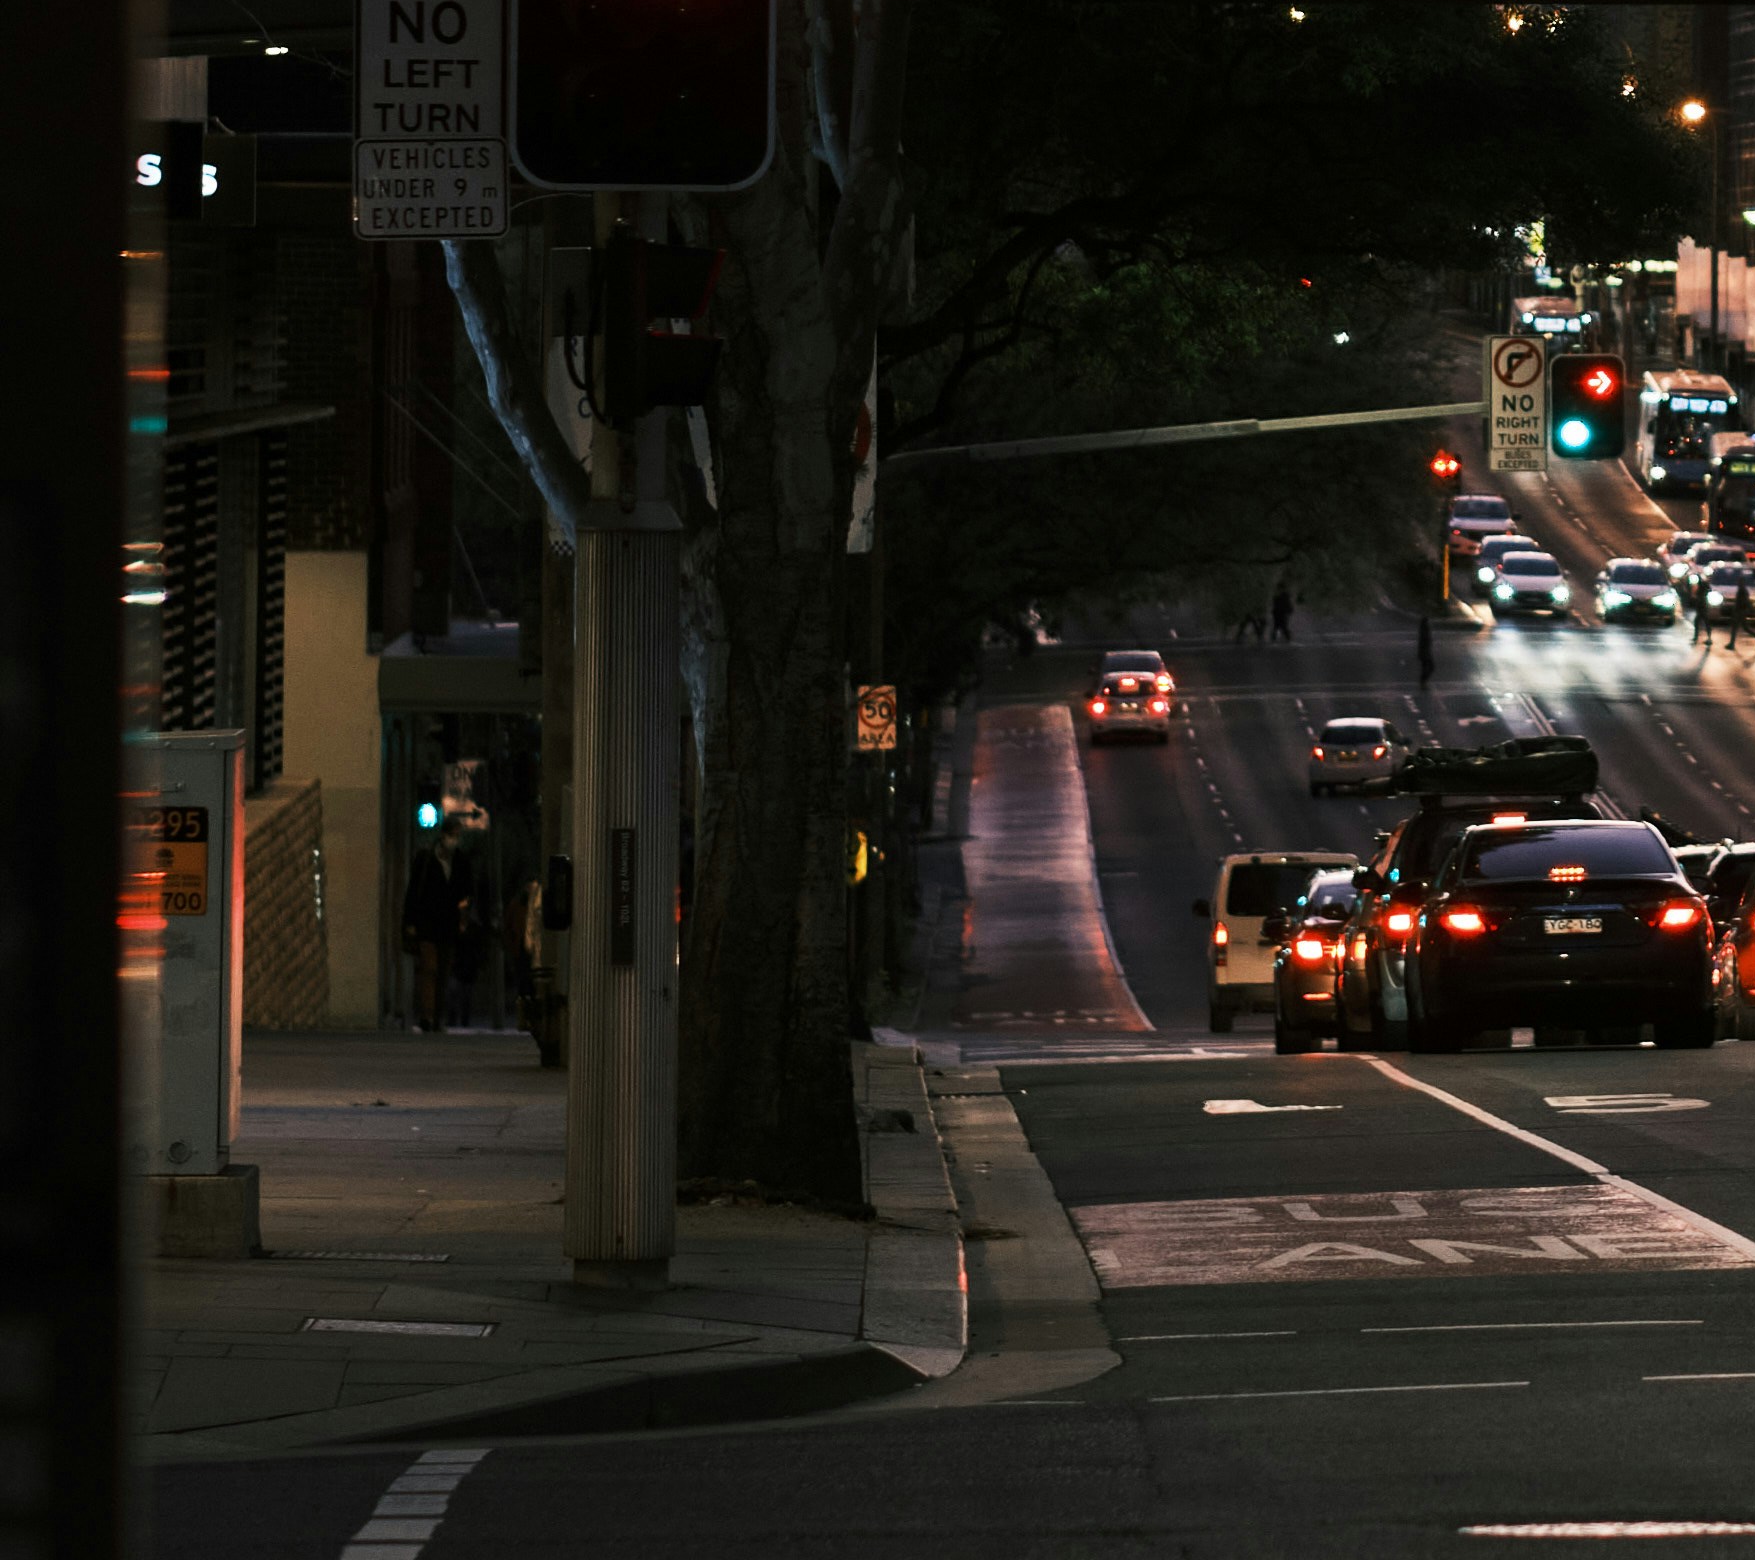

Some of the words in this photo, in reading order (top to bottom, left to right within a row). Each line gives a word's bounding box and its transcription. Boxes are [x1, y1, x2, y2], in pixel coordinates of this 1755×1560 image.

[390, 1, 467, 44] NO
[384, 60, 479, 88] LEFT
[374, 103, 479, 132] TURN
[373, 148, 490, 169] VEHICLES
[364, 180, 434, 198] UNDER
[455, 179, 467, 196] 9
[483, 186, 497, 197] m
[373, 207, 493, 228] EXCEPTED
[1502, 395, 1534, 411] NO
[1497, 417, 1539, 428] RIGHT
[1499, 434, 1539, 445] TURN
[863, 701, 893, 719] 50
